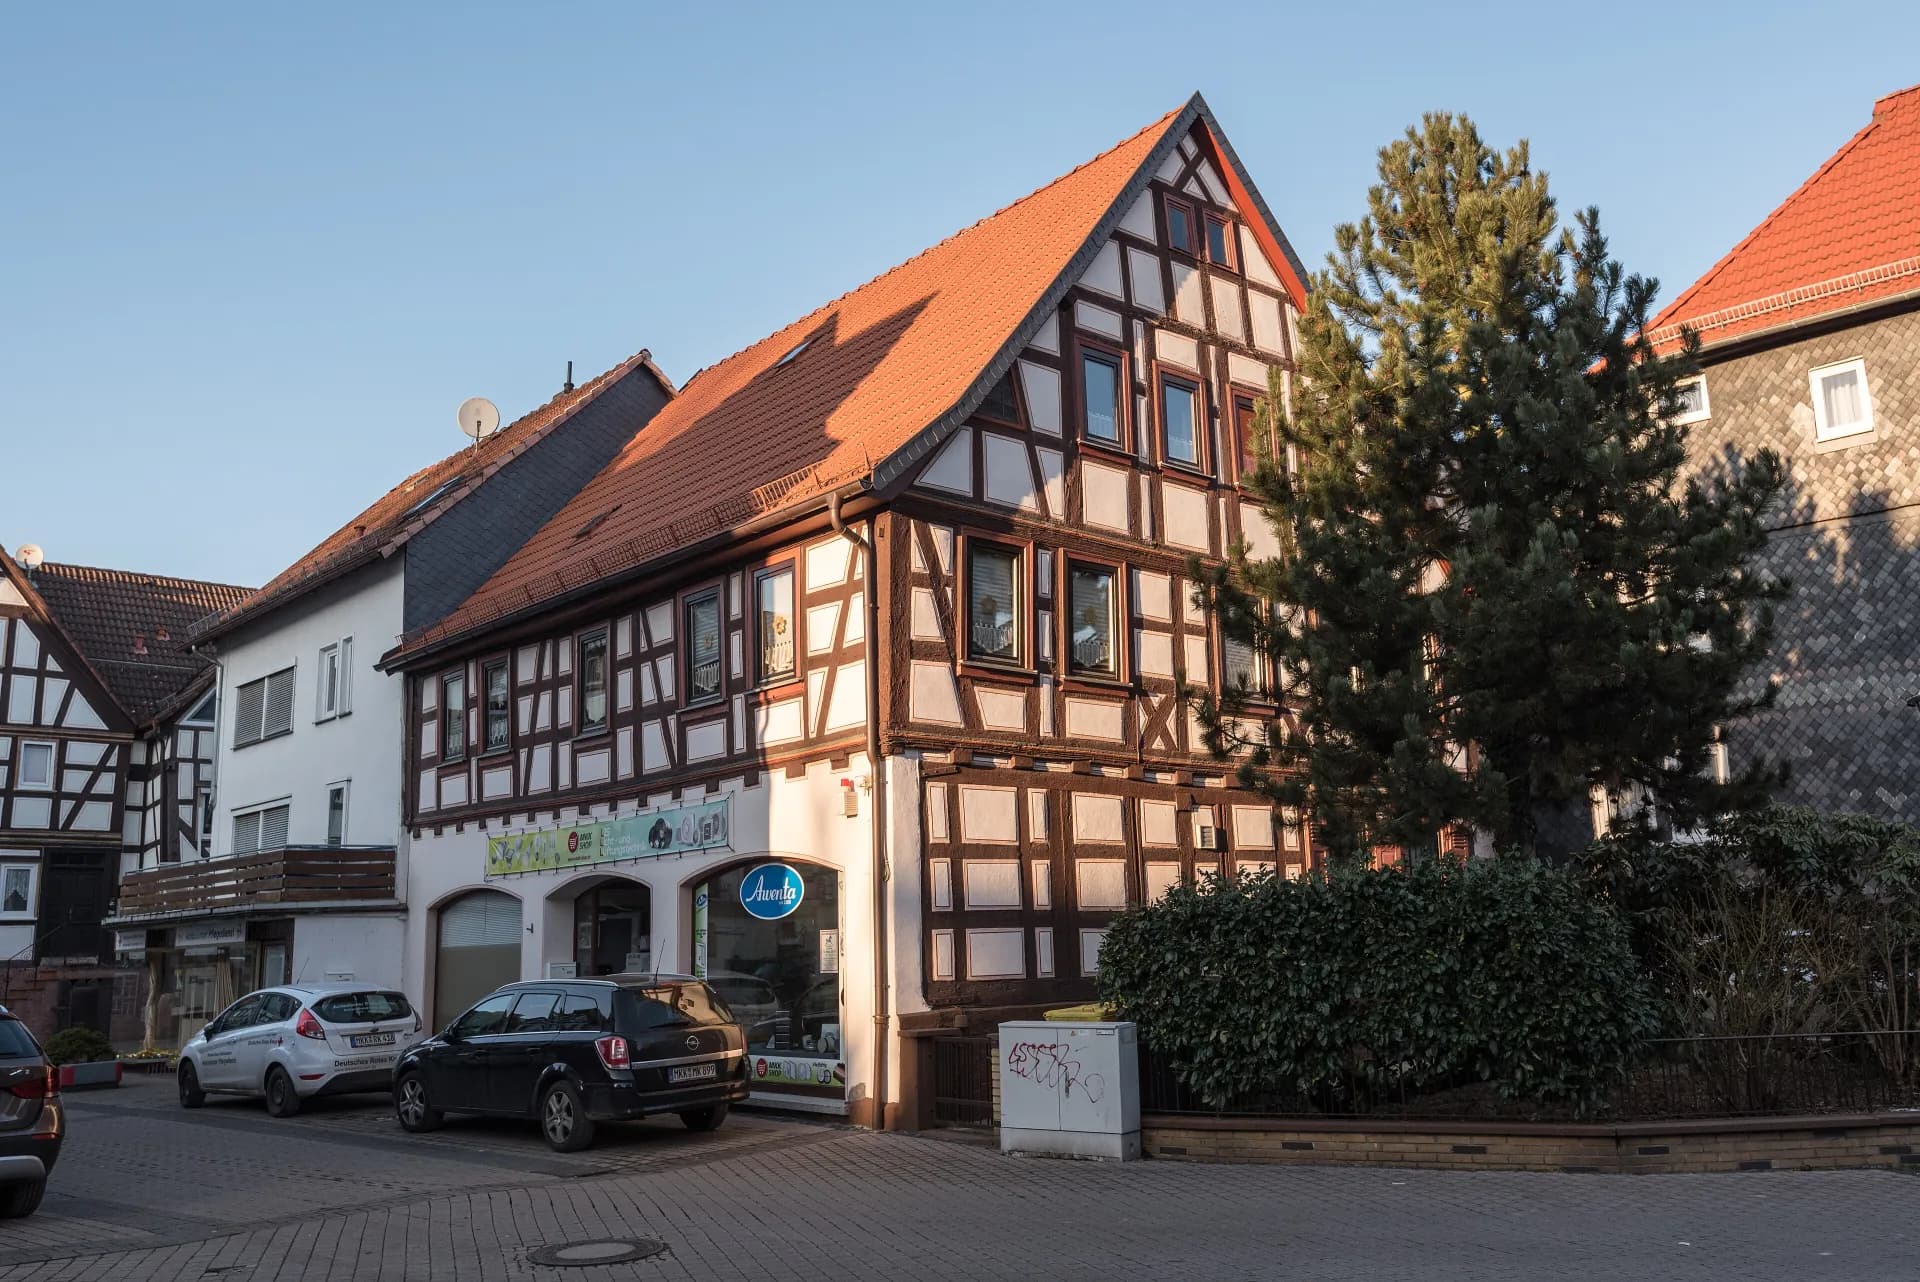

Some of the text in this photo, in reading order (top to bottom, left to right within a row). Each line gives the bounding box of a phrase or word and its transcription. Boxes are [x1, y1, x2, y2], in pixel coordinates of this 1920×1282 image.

[745, 874, 797, 902] Awenta
[334, 1059, 369, 1068] Deutsches
[702, 1064, 715, 1076] 899
